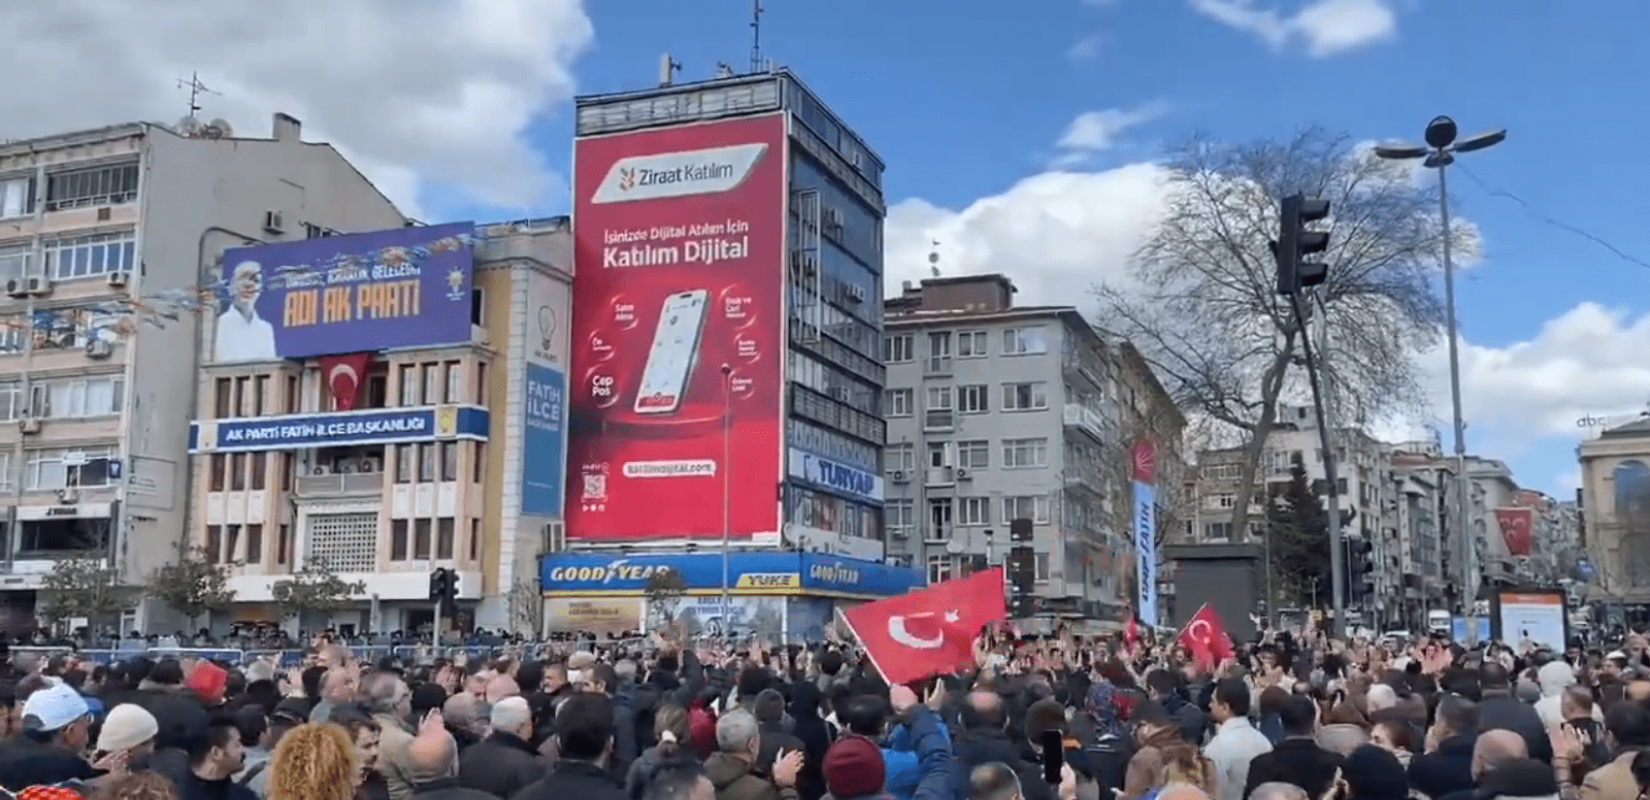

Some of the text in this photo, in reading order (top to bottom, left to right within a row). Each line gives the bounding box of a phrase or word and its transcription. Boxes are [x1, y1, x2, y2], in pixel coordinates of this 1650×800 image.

[639, 162, 733, 186] Ziraat Katılım
[650, 224, 685, 241] Dijital
[603, 235, 749, 268] Katılım Dijital
[283, 289, 318, 327] ADI
[323, 285, 351, 323] AK
[226, 429, 244, 441] AK
